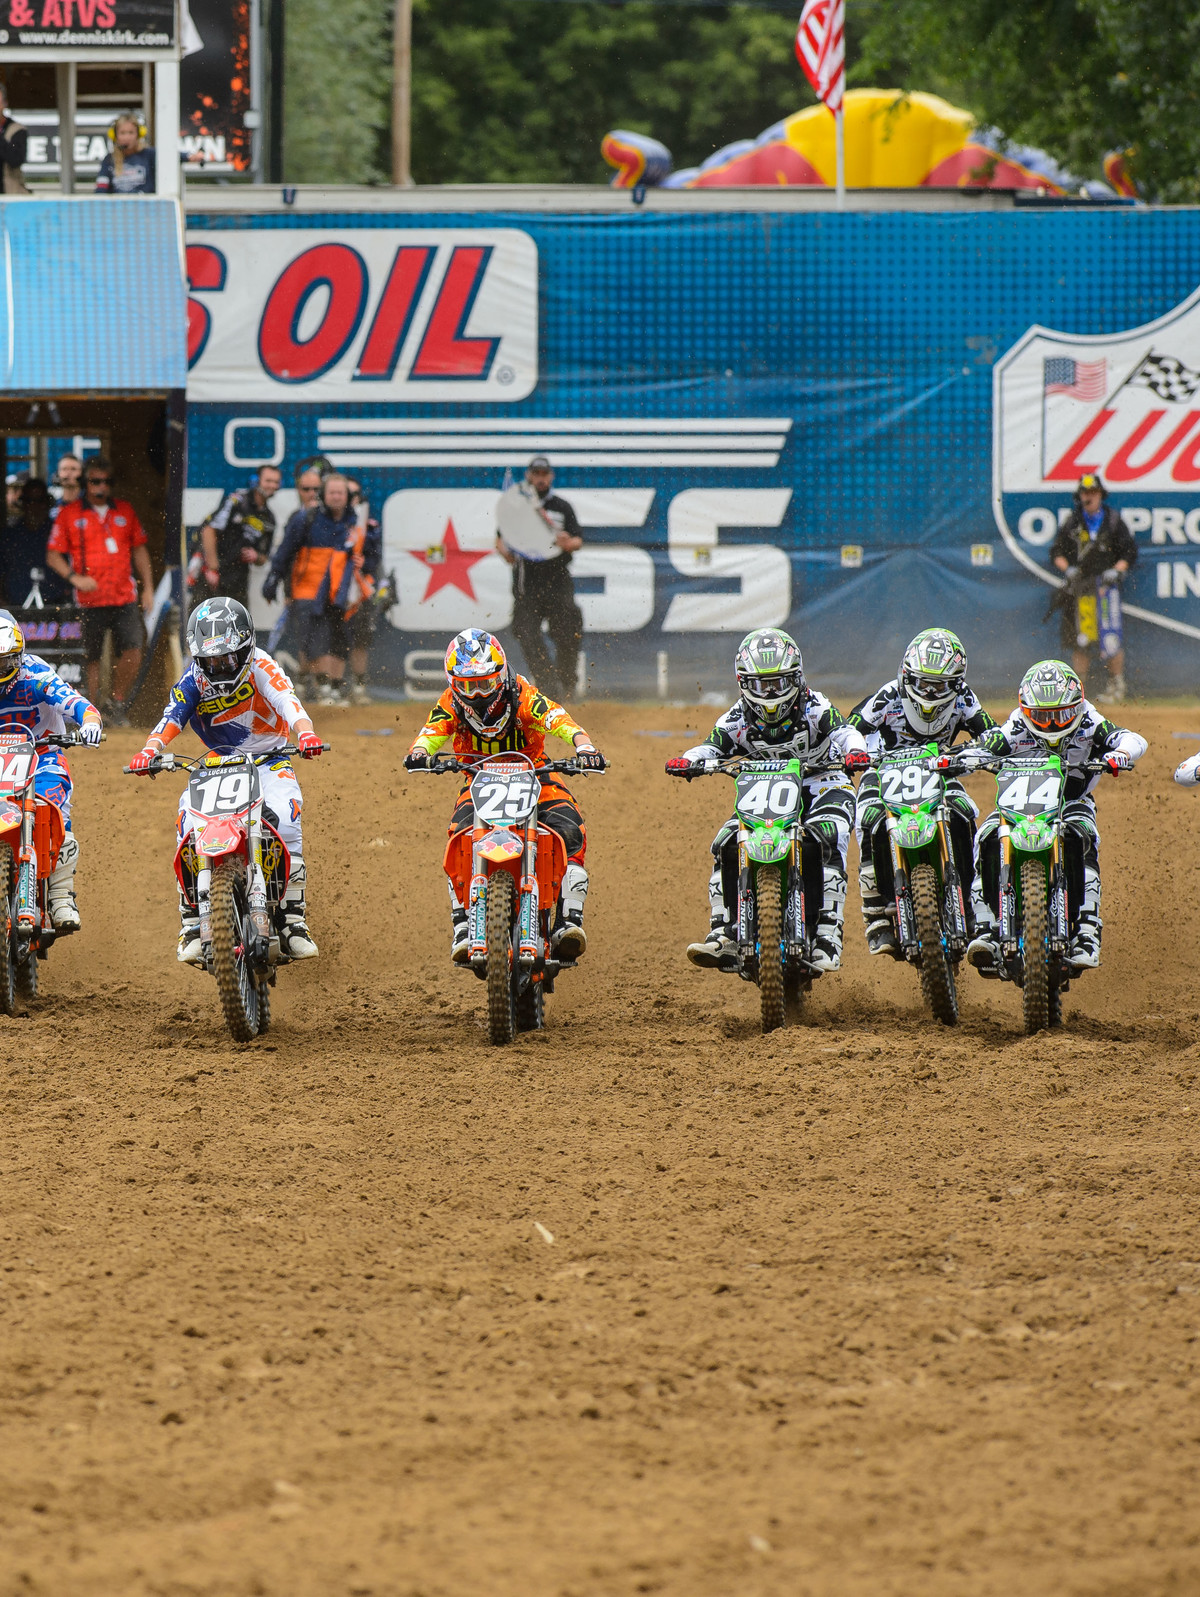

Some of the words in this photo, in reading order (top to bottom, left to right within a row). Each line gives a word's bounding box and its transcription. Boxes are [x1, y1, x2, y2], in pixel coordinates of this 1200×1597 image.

[8, 0, 35, 27] &
[40, 0, 117, 28] ATVS
[18, 29, 169, 46] www.denniskirk.com
[257, 242, 502, 385] OIL
[196, 682, 255, 716] GEICO
[207, 768, 228, 776] LUCAS
[881, 765, 941, 802] 292
[196, 772, 255, 815] 19
[477, 782, 538, 820] 25
[737, 779, 799, 815] 40
[998, 775, 1061, 811] 44
[27, 864, 36, 909] DUNLOP
[469, 886, 477, 940] DNLOP
[476, 899, 486, 938] MOTOREX
[529, 894, 538, 940] DUNLOP
[794, 889, 802, 937] DUNLOP
[951, 884, 963, 931] DUNLOP
[1056, 887, 1065, 937] DUNLOP
